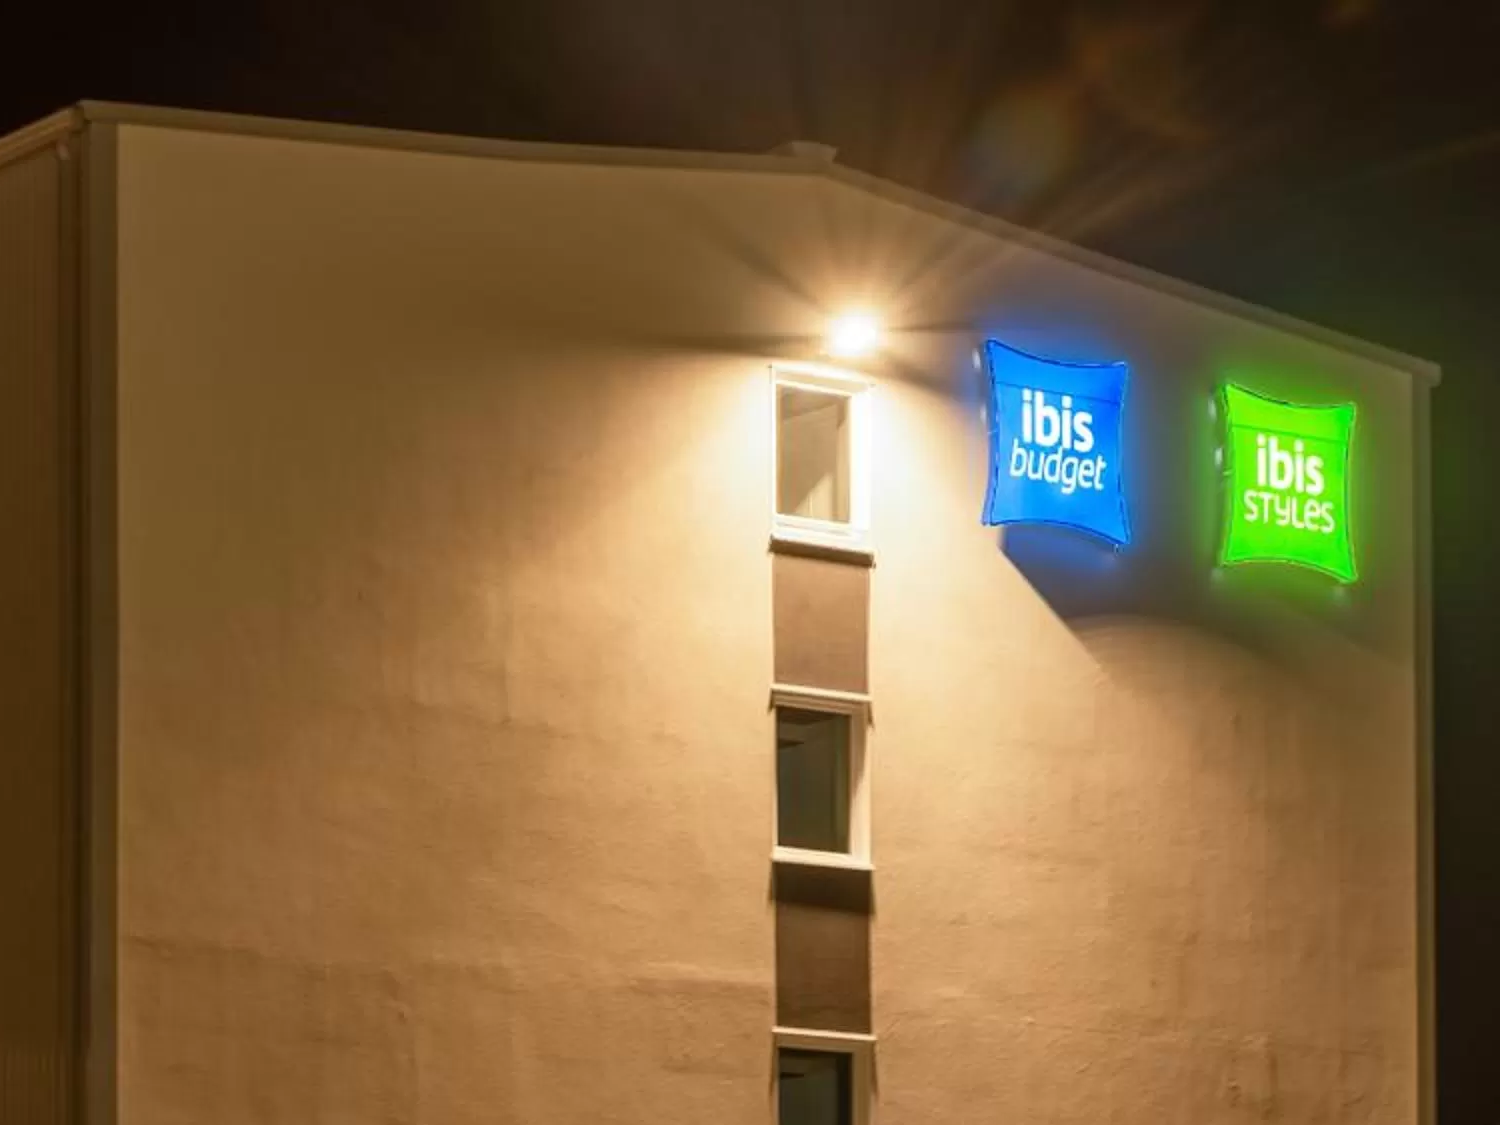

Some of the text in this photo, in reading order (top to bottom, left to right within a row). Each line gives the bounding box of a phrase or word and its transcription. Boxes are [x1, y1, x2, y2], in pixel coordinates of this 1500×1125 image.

[1022, 387, 1094, 452] ibis
[1010, 437, 1107, 494] budget
[1256, 432, 1324, 496] ibis
